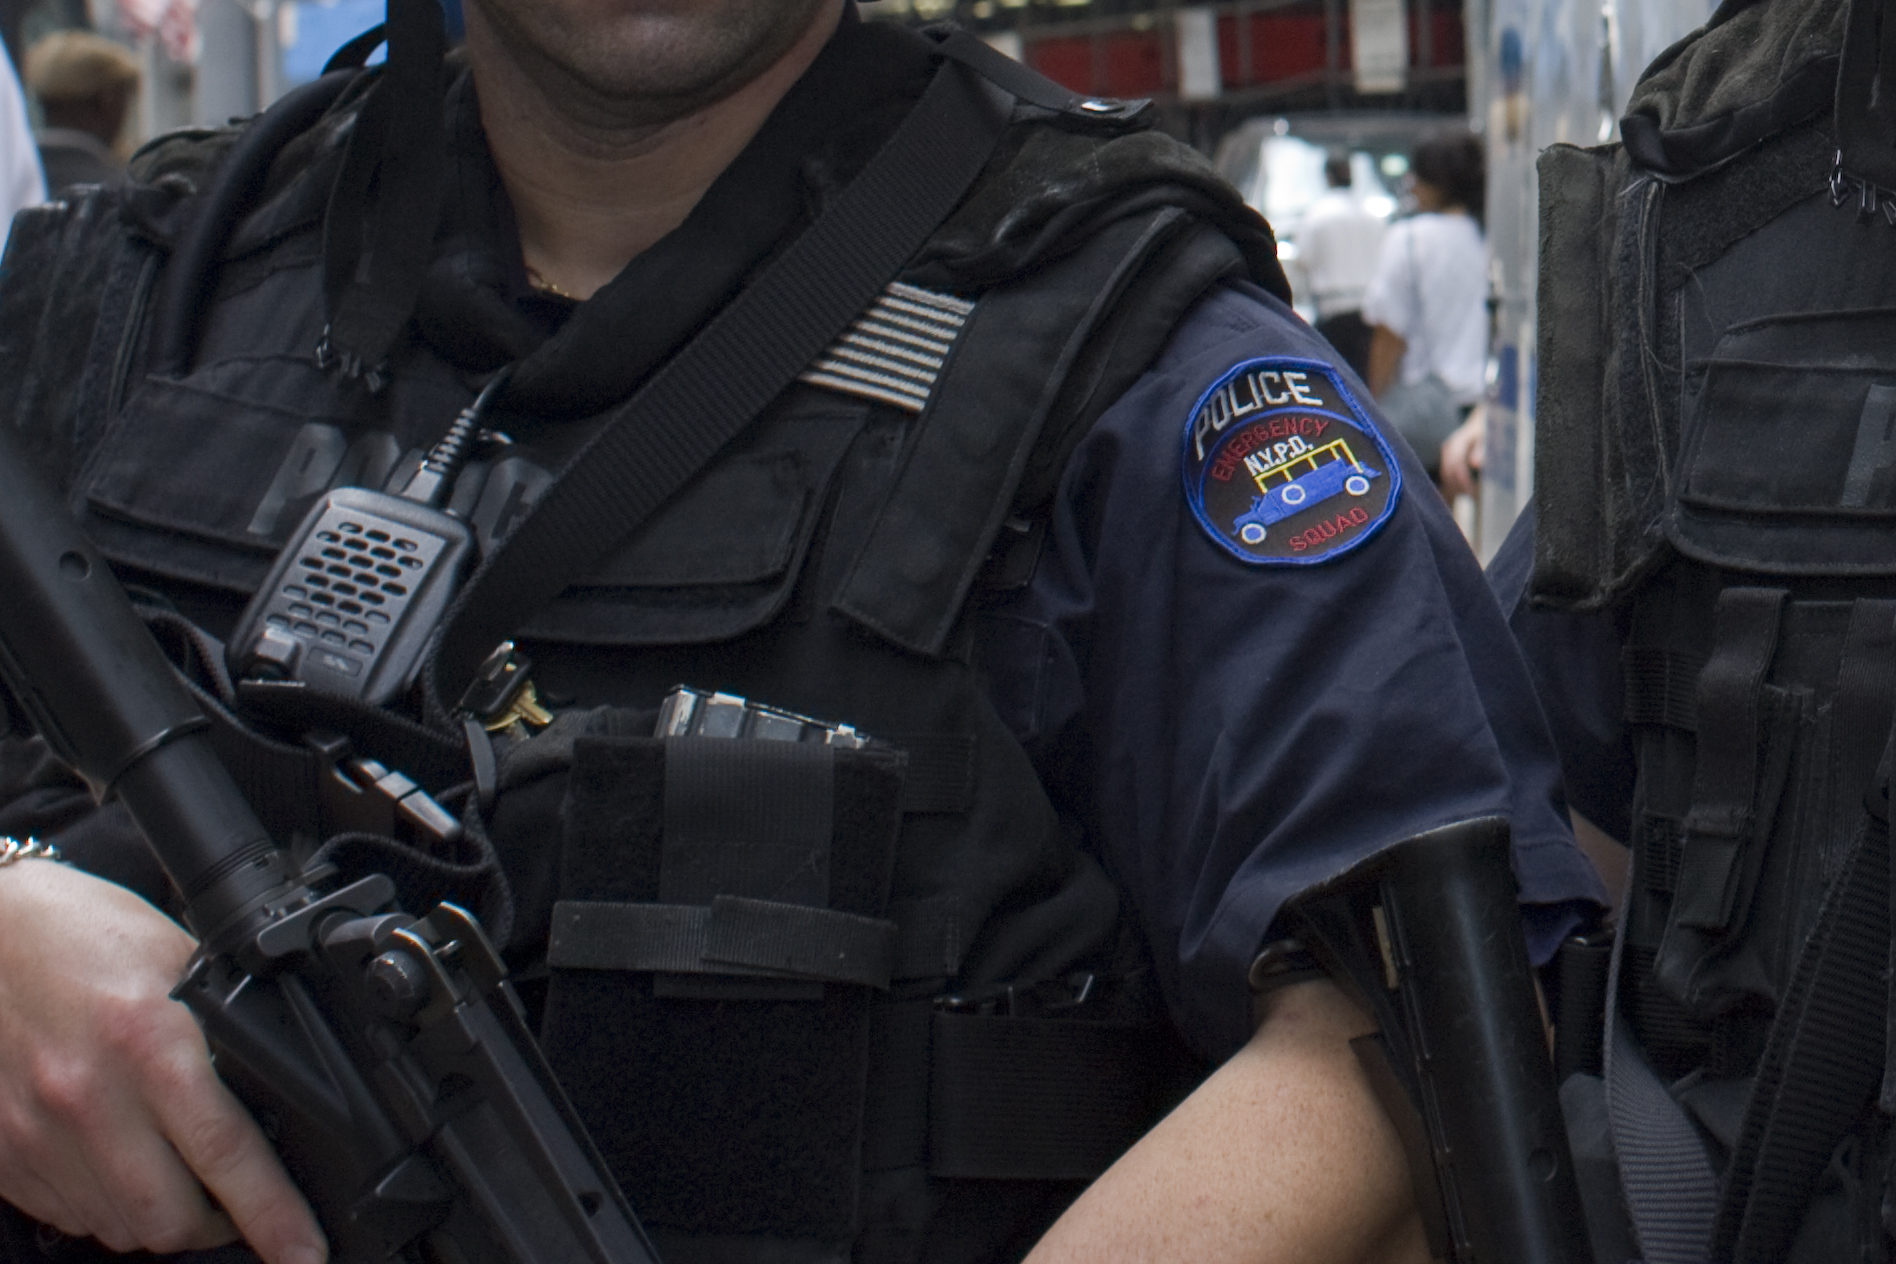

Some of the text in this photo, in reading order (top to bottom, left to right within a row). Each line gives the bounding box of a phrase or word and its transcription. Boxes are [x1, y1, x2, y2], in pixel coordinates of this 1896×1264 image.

[1195, 371, 1323, 461] POLICE
[1211, 417, 1329, 481] EMERGENCY
[1243, 435, 1314, 476] N.Y.P.D.
[1289, 506, 1369, 552] SQUAD
